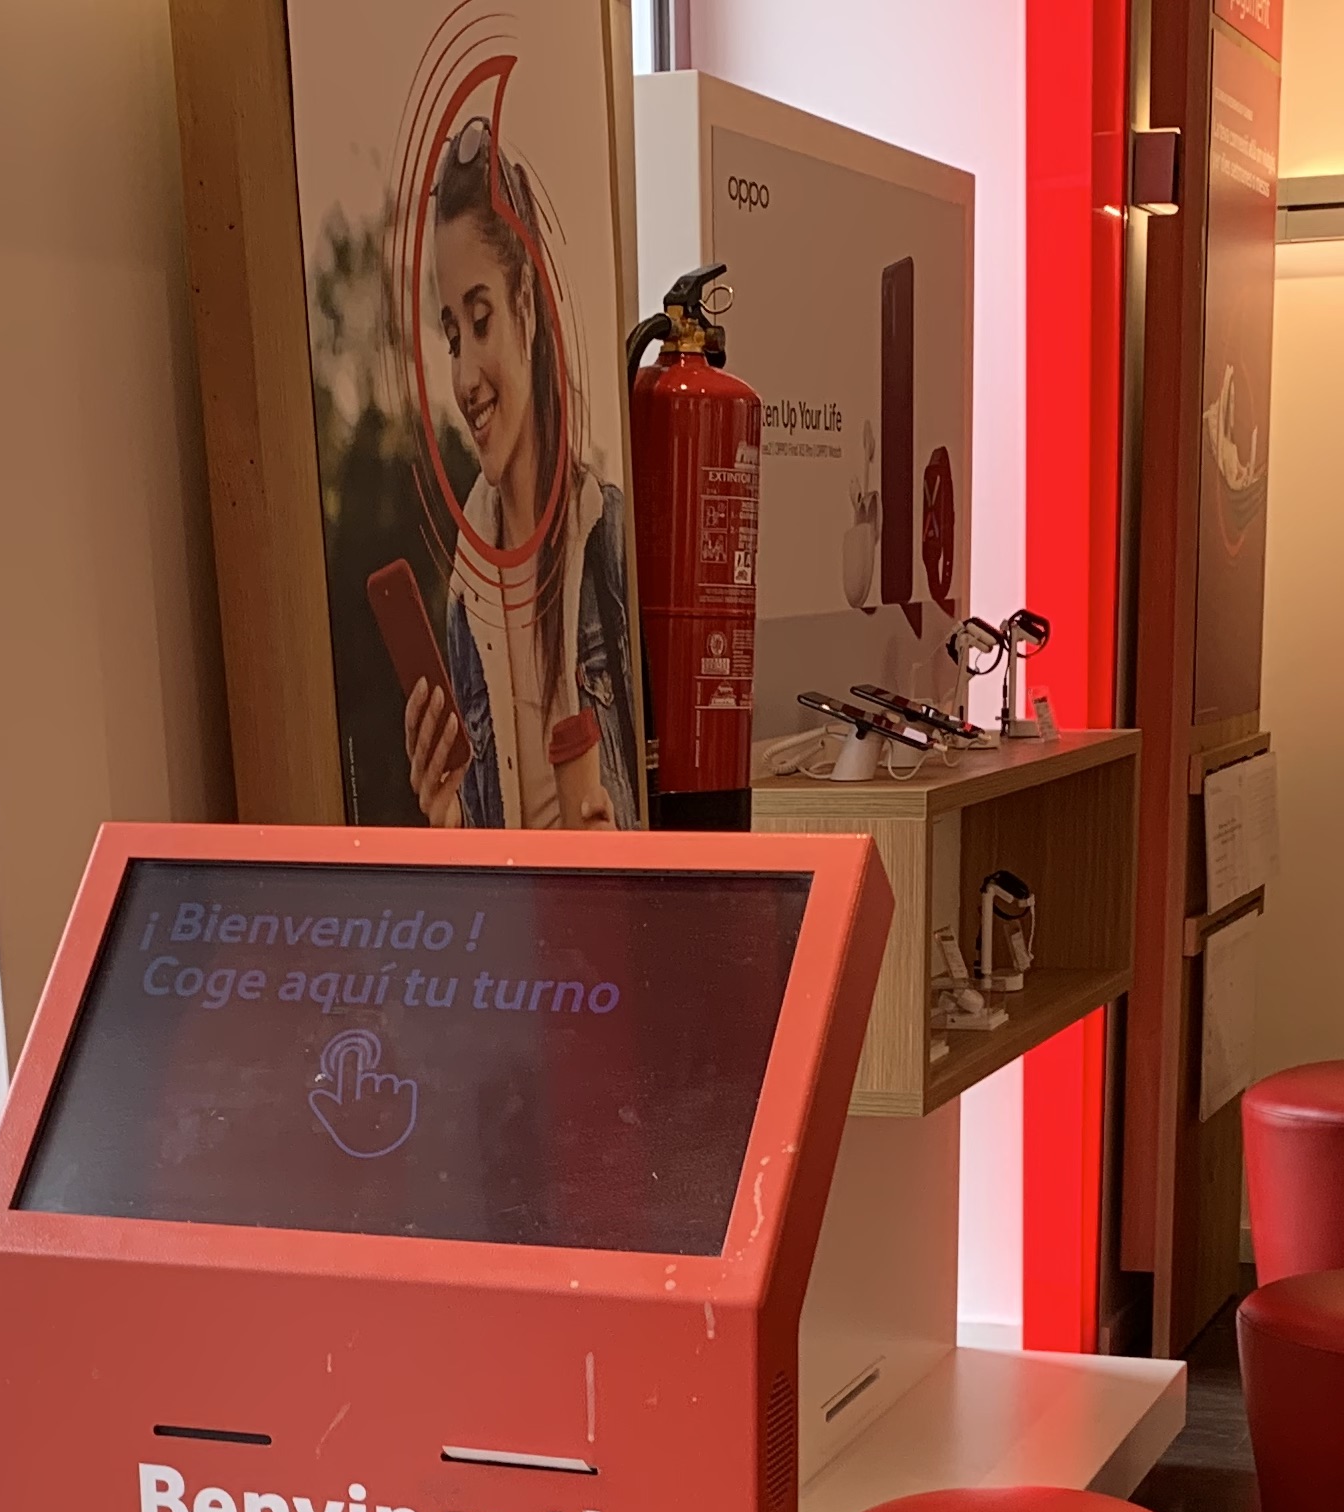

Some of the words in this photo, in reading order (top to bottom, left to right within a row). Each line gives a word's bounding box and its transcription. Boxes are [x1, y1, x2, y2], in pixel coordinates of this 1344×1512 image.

[728, 175, 770, 213] oppo
[781, 400, 797, 436] Up
[798, 401, 822, 431] Your
[823, 403, 843, 433] Life
[139, 912, 159, 951] ¡
[170, 901, 454, 951] Bienvenido
[465, 912, 485, 951] !
[142, 957, 267, 1009] Coge
[278, 962, 397, 1015] aquí
[403, 968, 458, 1008] tu
[472, 971, 621, 1014] turno
